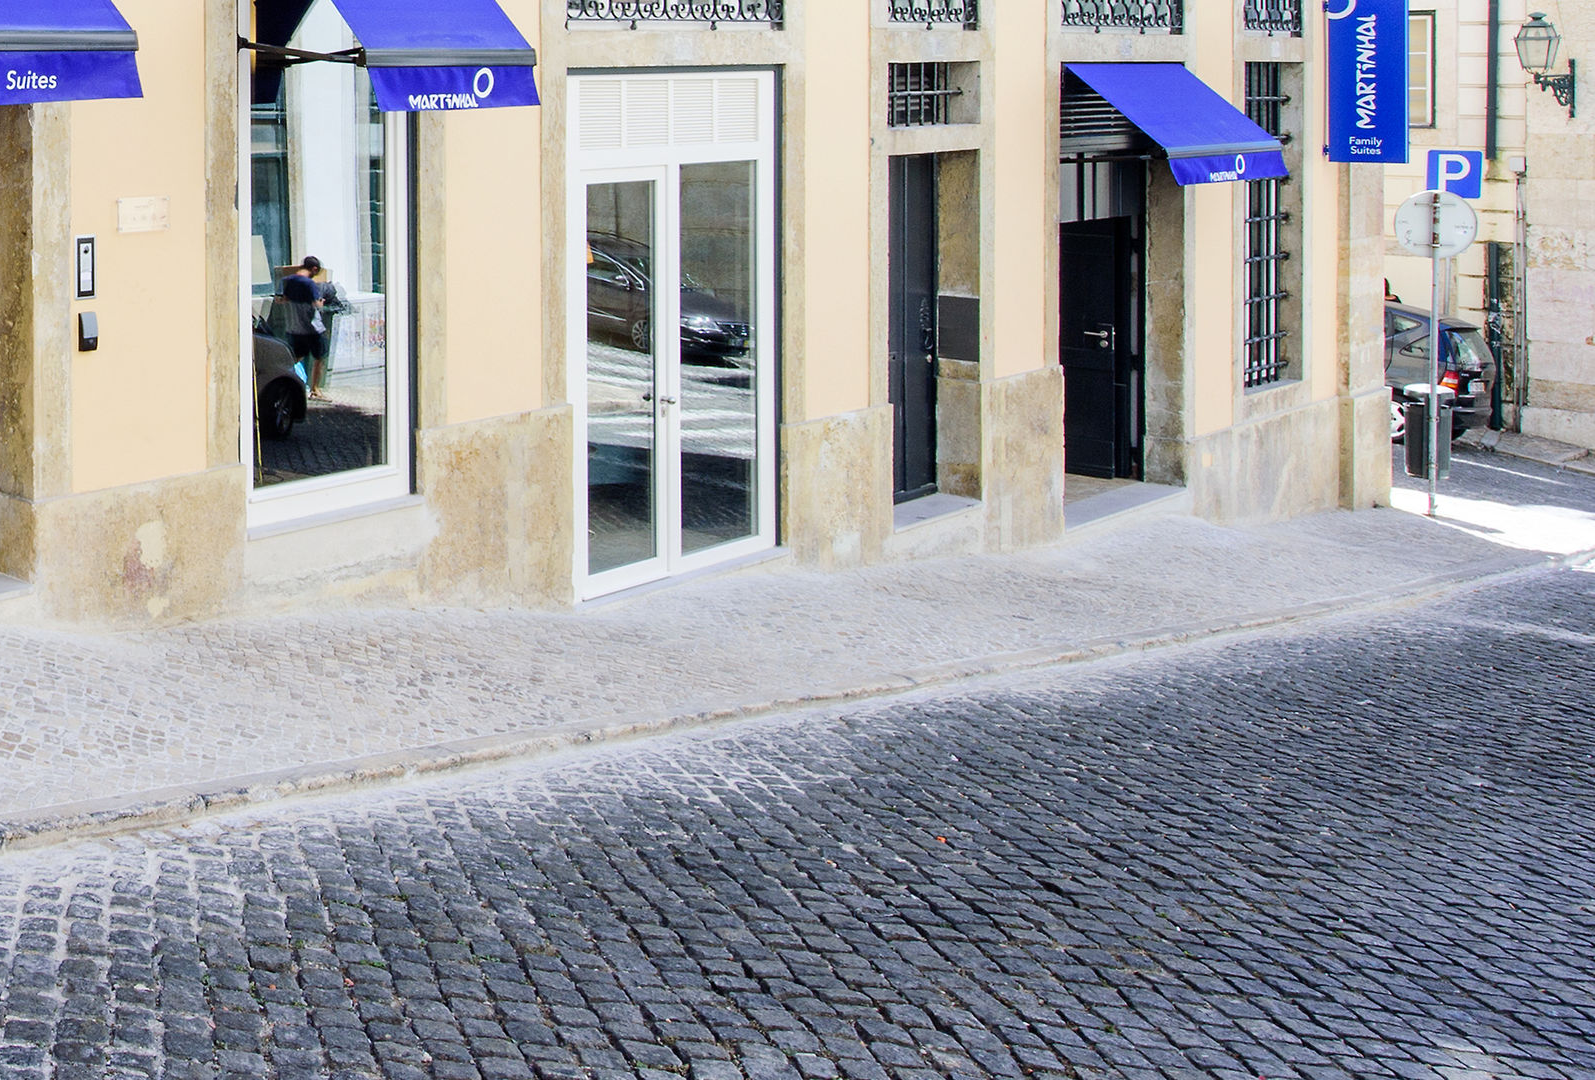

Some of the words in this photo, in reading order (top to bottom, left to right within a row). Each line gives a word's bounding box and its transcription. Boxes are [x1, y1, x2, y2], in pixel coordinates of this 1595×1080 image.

[5, 69, 58, 91] Suites
[1348, 135, 1383, 148] Family
[1349, 145, 1382, 155] Suites
[1437, 153, 1472, 191] P
